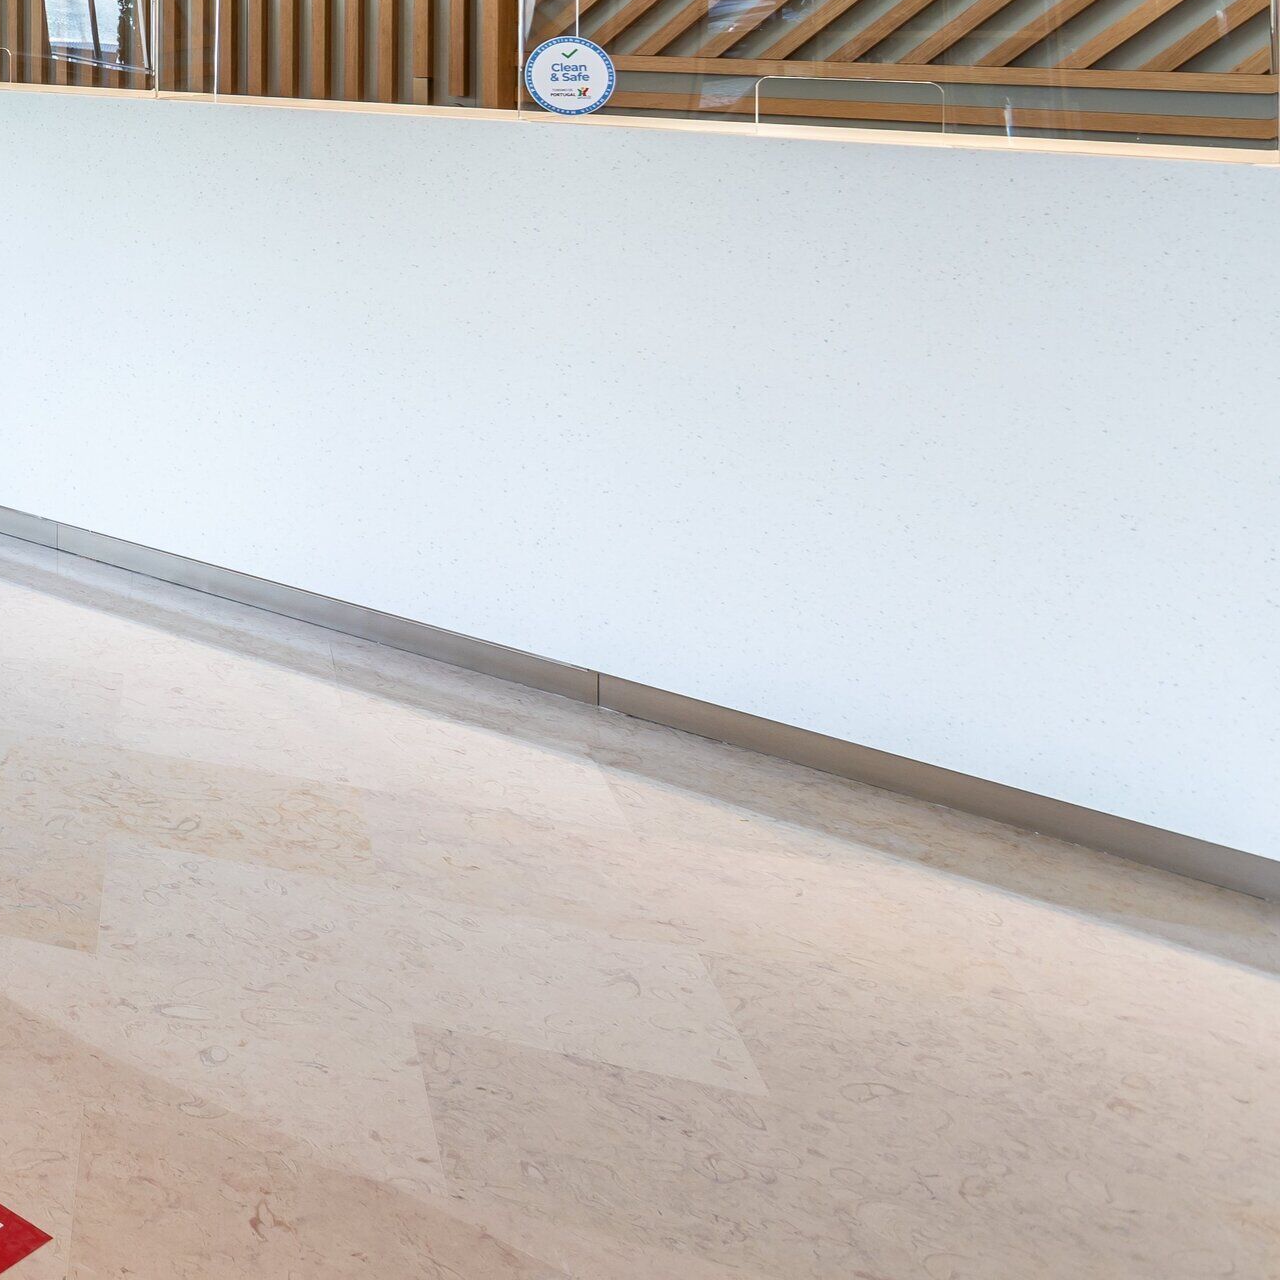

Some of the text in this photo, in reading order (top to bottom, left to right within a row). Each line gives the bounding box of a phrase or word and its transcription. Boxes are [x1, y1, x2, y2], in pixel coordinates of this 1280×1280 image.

[551, 63, 587, 72] Clean
[550, 72, 590, 82] & Safe
